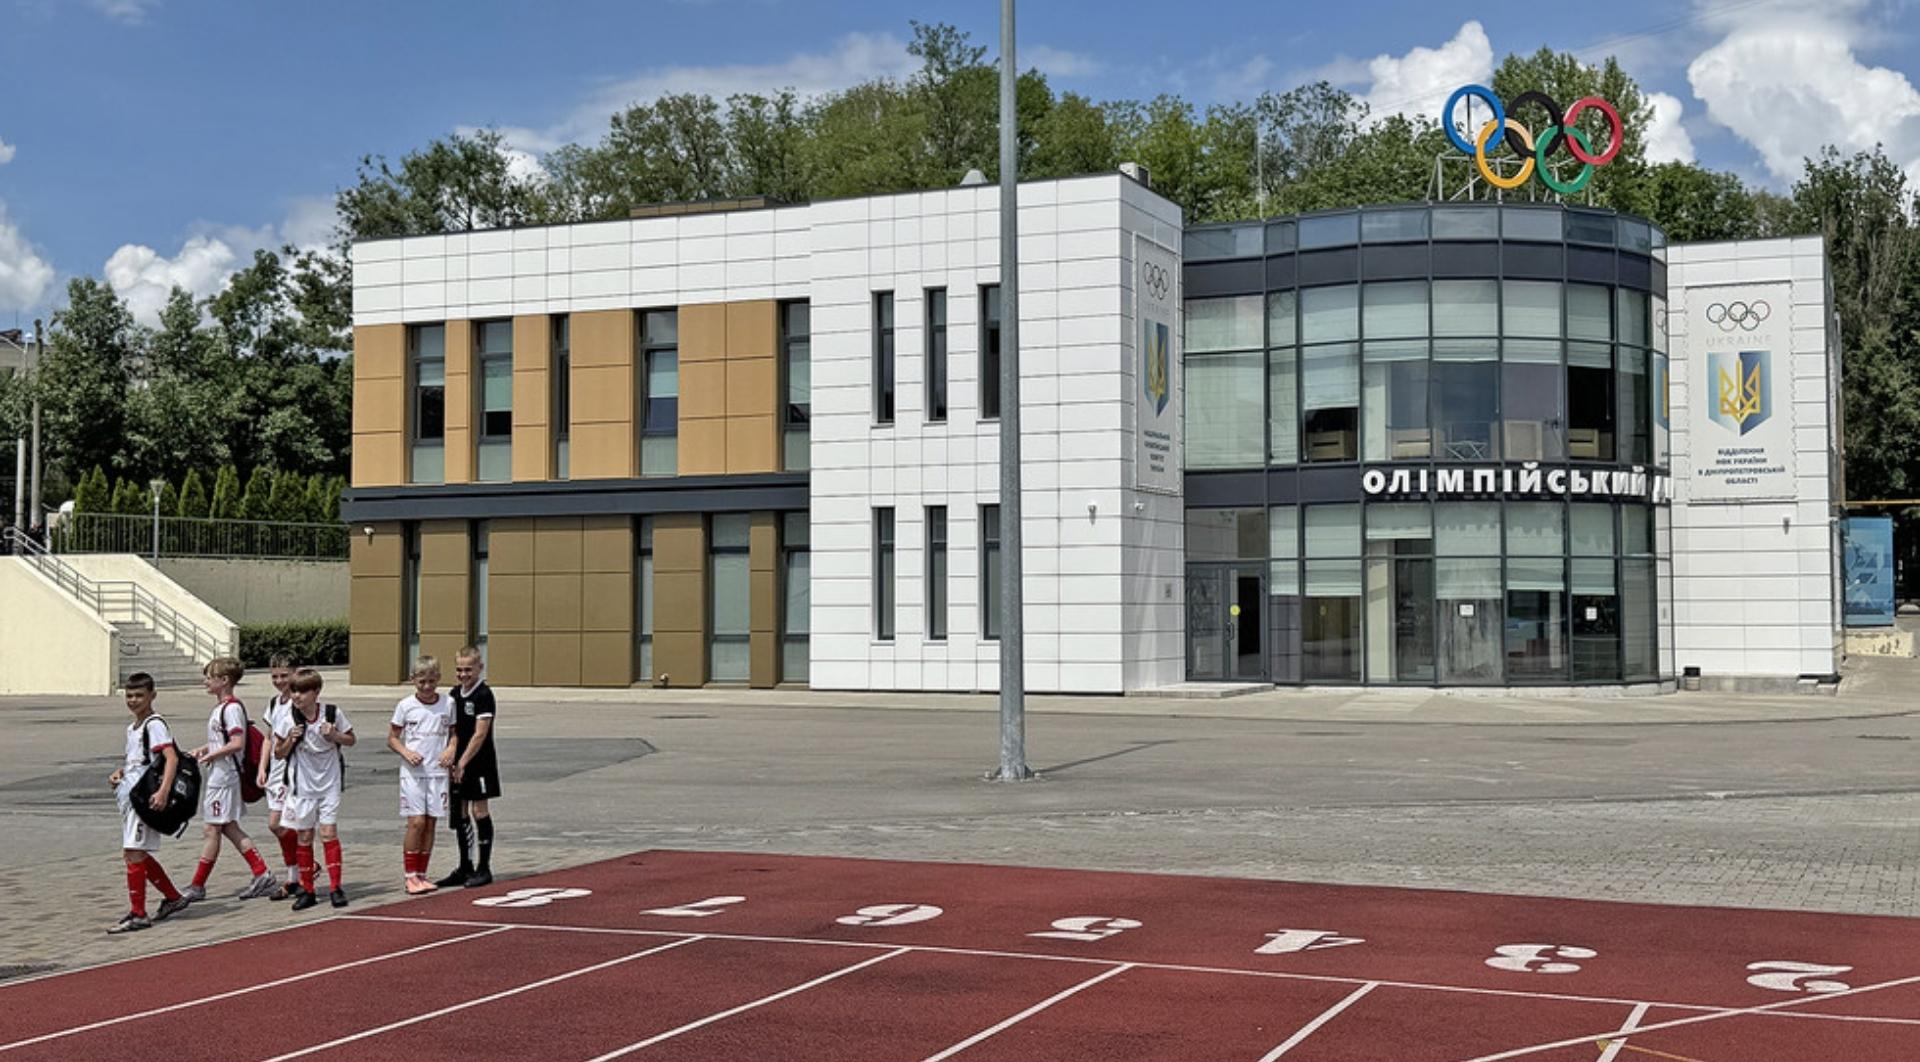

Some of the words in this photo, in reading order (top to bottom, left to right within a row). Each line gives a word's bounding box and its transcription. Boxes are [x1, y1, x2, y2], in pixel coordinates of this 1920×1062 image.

[1706, 334, 1773, 347] UKRAINE
[1733, 456, 1768, 465] УКРАЇНИ
[1363, 461, 1646, 496] ОЛІМПІЙСЬКИЙ
[1725, 477, 1759, 485] ОБЛАСТІ
[211, 800, 221, 817] 6
[135, 823, 144, 842] 5
[471, 887, 592, 907] 8
[641, 896, 746, 917] 7
[835, 904, 943, 926] 6
[1026, 916, 1143, 941] 5
[1253, 928, 1366, 954] 4
[1484, 944, 1598, 973] 3
[1746, 960, 1854, 993] 2
